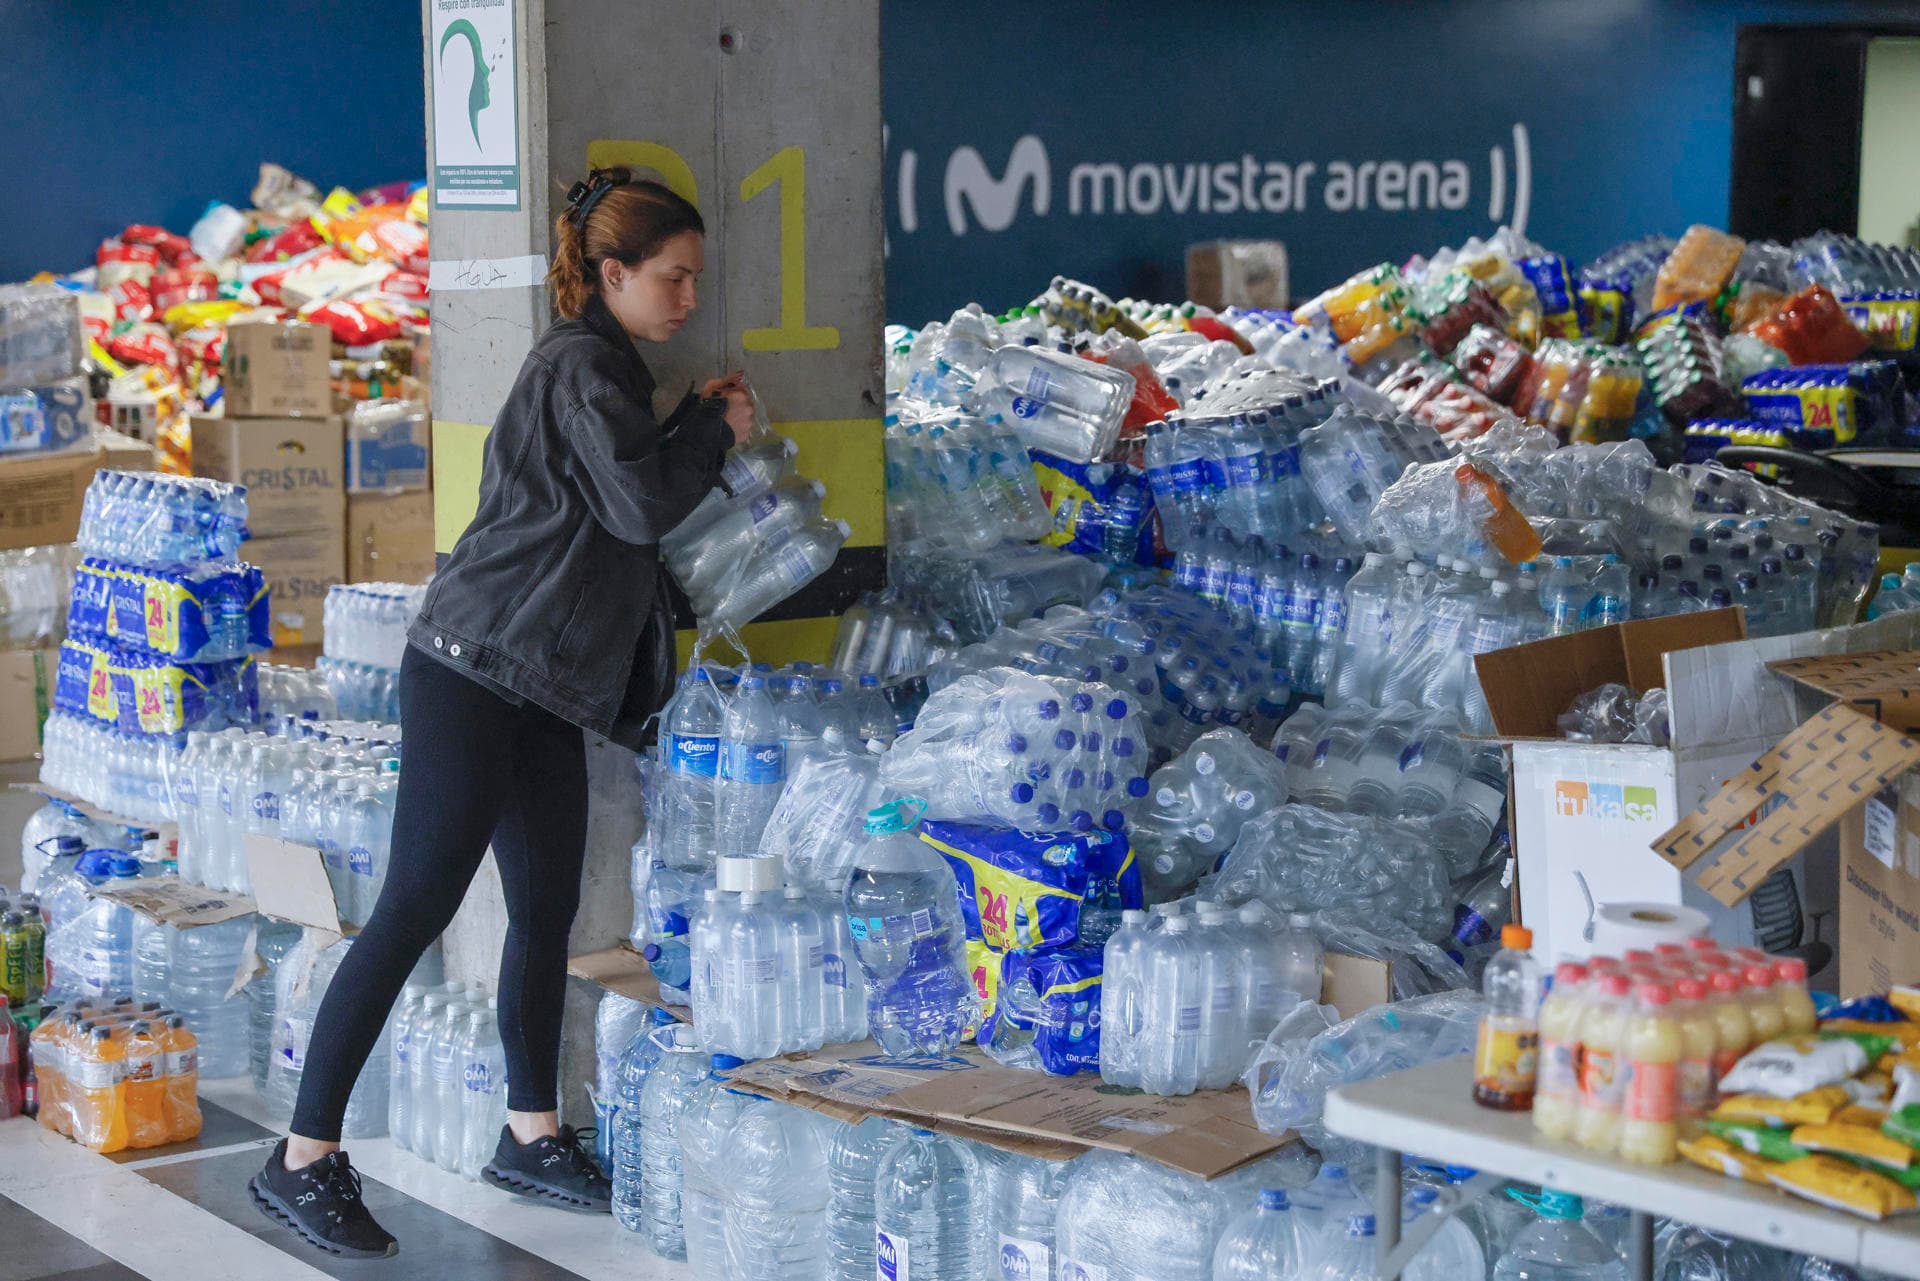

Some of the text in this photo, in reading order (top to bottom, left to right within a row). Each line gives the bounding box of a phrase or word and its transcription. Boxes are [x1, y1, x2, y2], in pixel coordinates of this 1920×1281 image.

[1069, 153, 1315, 215] movistar
[1324, 159, 1470, 213] arena
[1808, 403, 1833, 427] 24
[239, 465, 335, 491] CRISTAL
[147, 597, 164, 629] 24
[142, 688, 161, 715] 24
[678, 740, 716, 754] aCuenta
[979, 885, 1009, 934] 24
